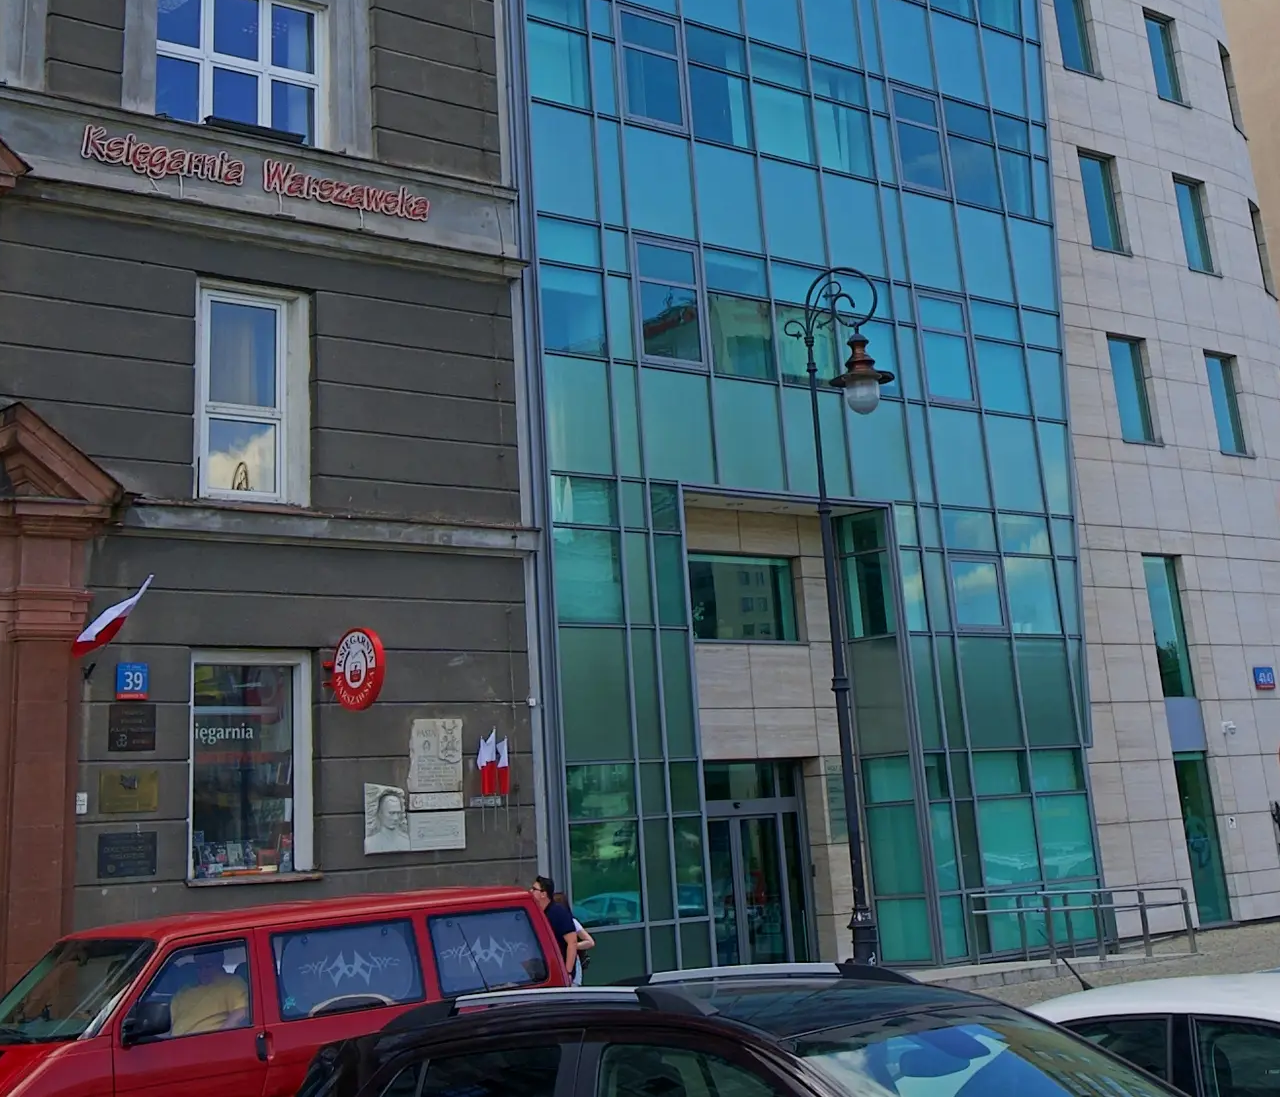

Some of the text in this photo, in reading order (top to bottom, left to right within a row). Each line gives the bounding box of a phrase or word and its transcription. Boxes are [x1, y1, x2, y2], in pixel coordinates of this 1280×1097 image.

[81, 124, 430, 222] Księgarnia Warszawska
[123, 671, 144, 691] 39
